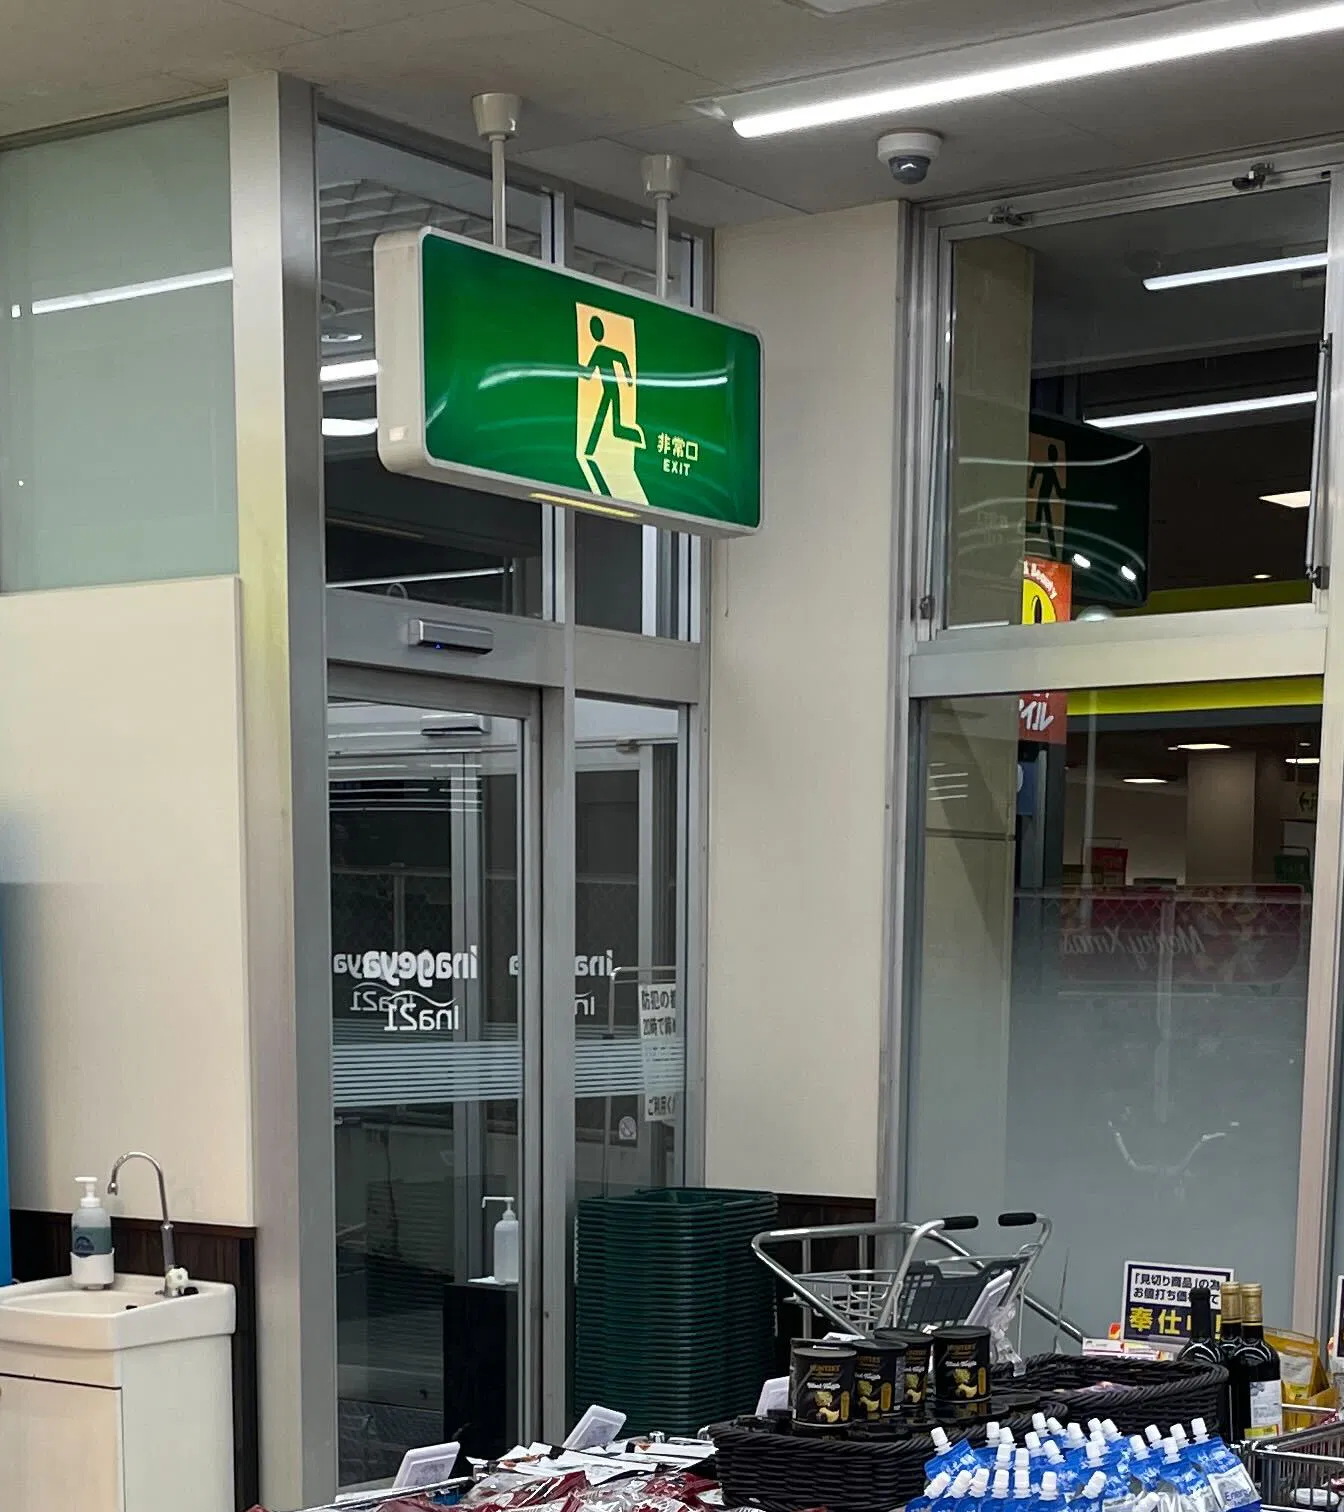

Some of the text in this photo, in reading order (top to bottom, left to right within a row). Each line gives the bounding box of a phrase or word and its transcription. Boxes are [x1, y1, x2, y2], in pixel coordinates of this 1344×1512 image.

[656, 432, 699, 462] 非常口
[662, 458, 691, 477] EXIT
